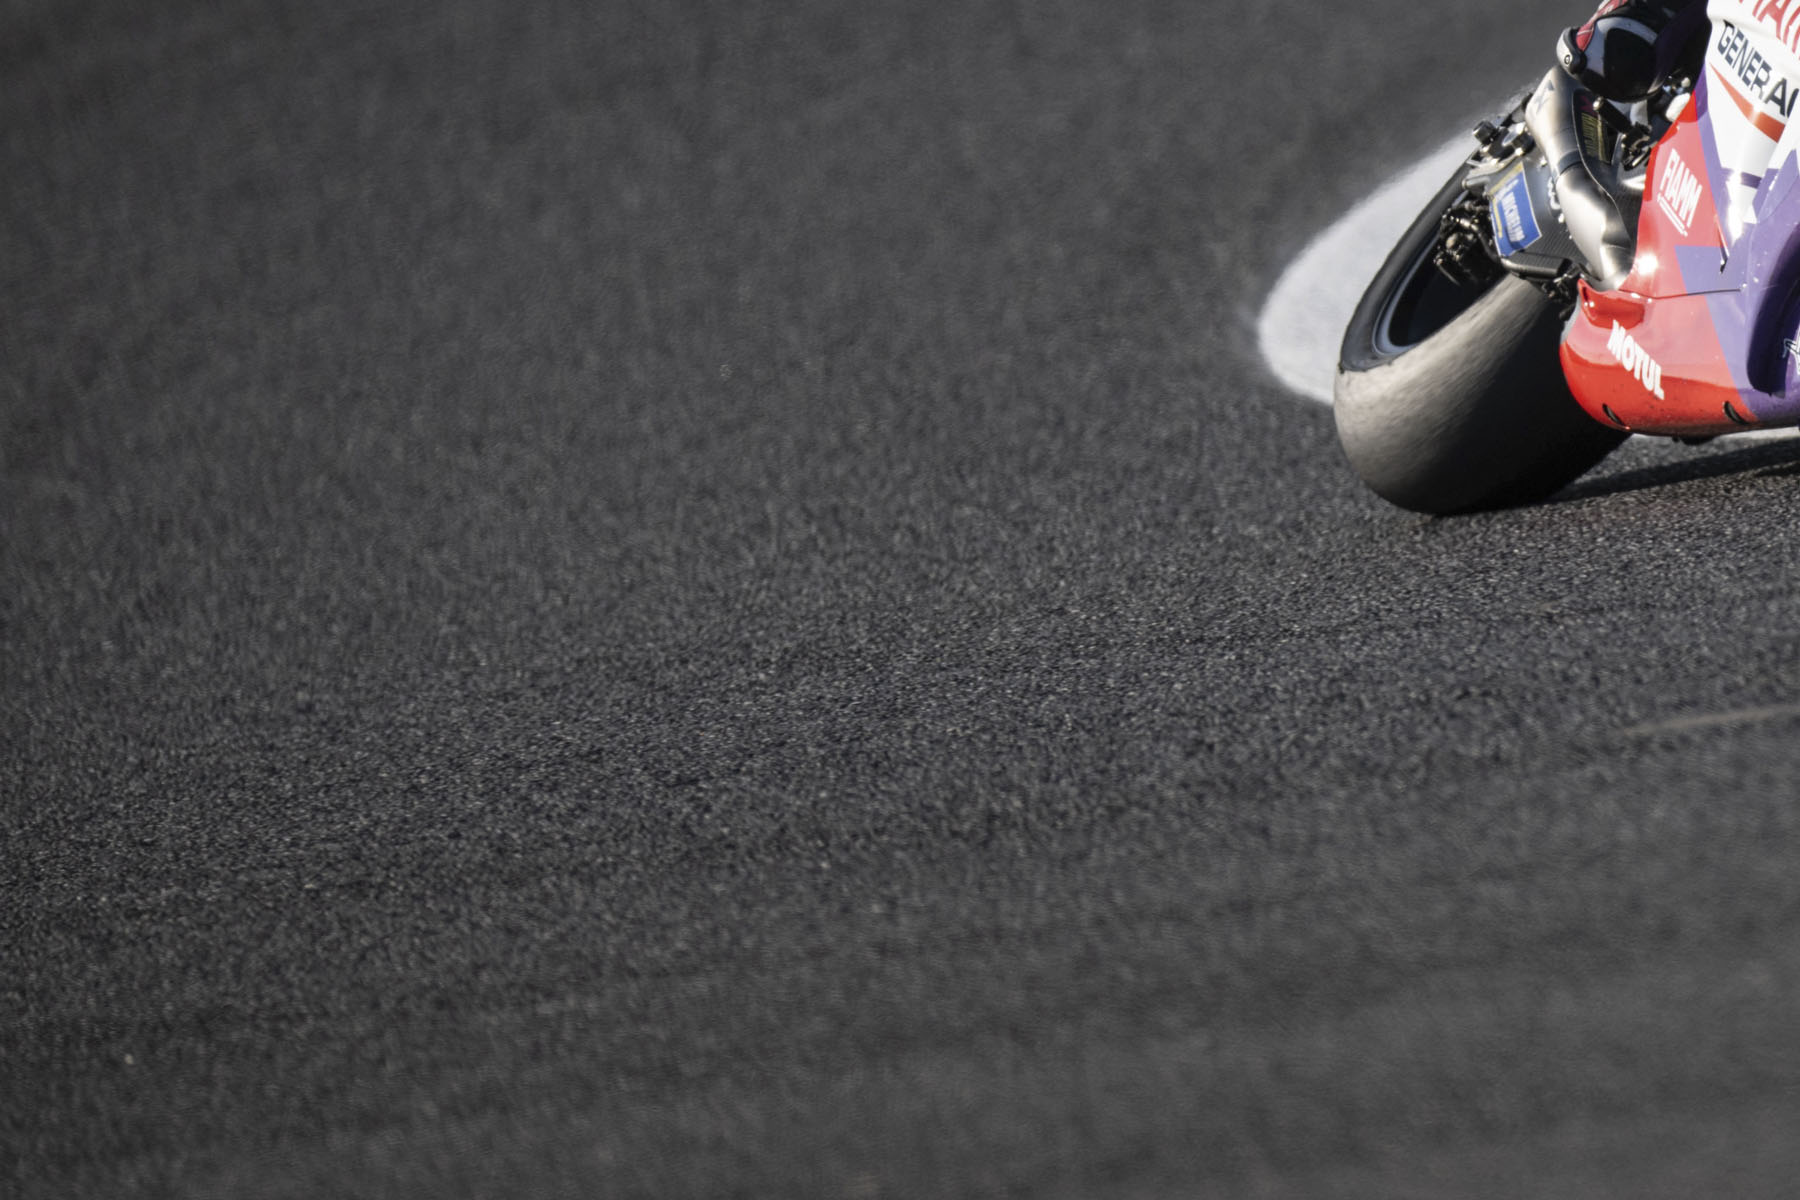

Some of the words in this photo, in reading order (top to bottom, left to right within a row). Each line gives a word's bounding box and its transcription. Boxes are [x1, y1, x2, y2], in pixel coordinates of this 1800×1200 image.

[1502, 191, 1525, 243] MICHELIN
[1659, 148, 1703, 228] FIAMM
[1606, 319, 1665, 400] MOTUL
